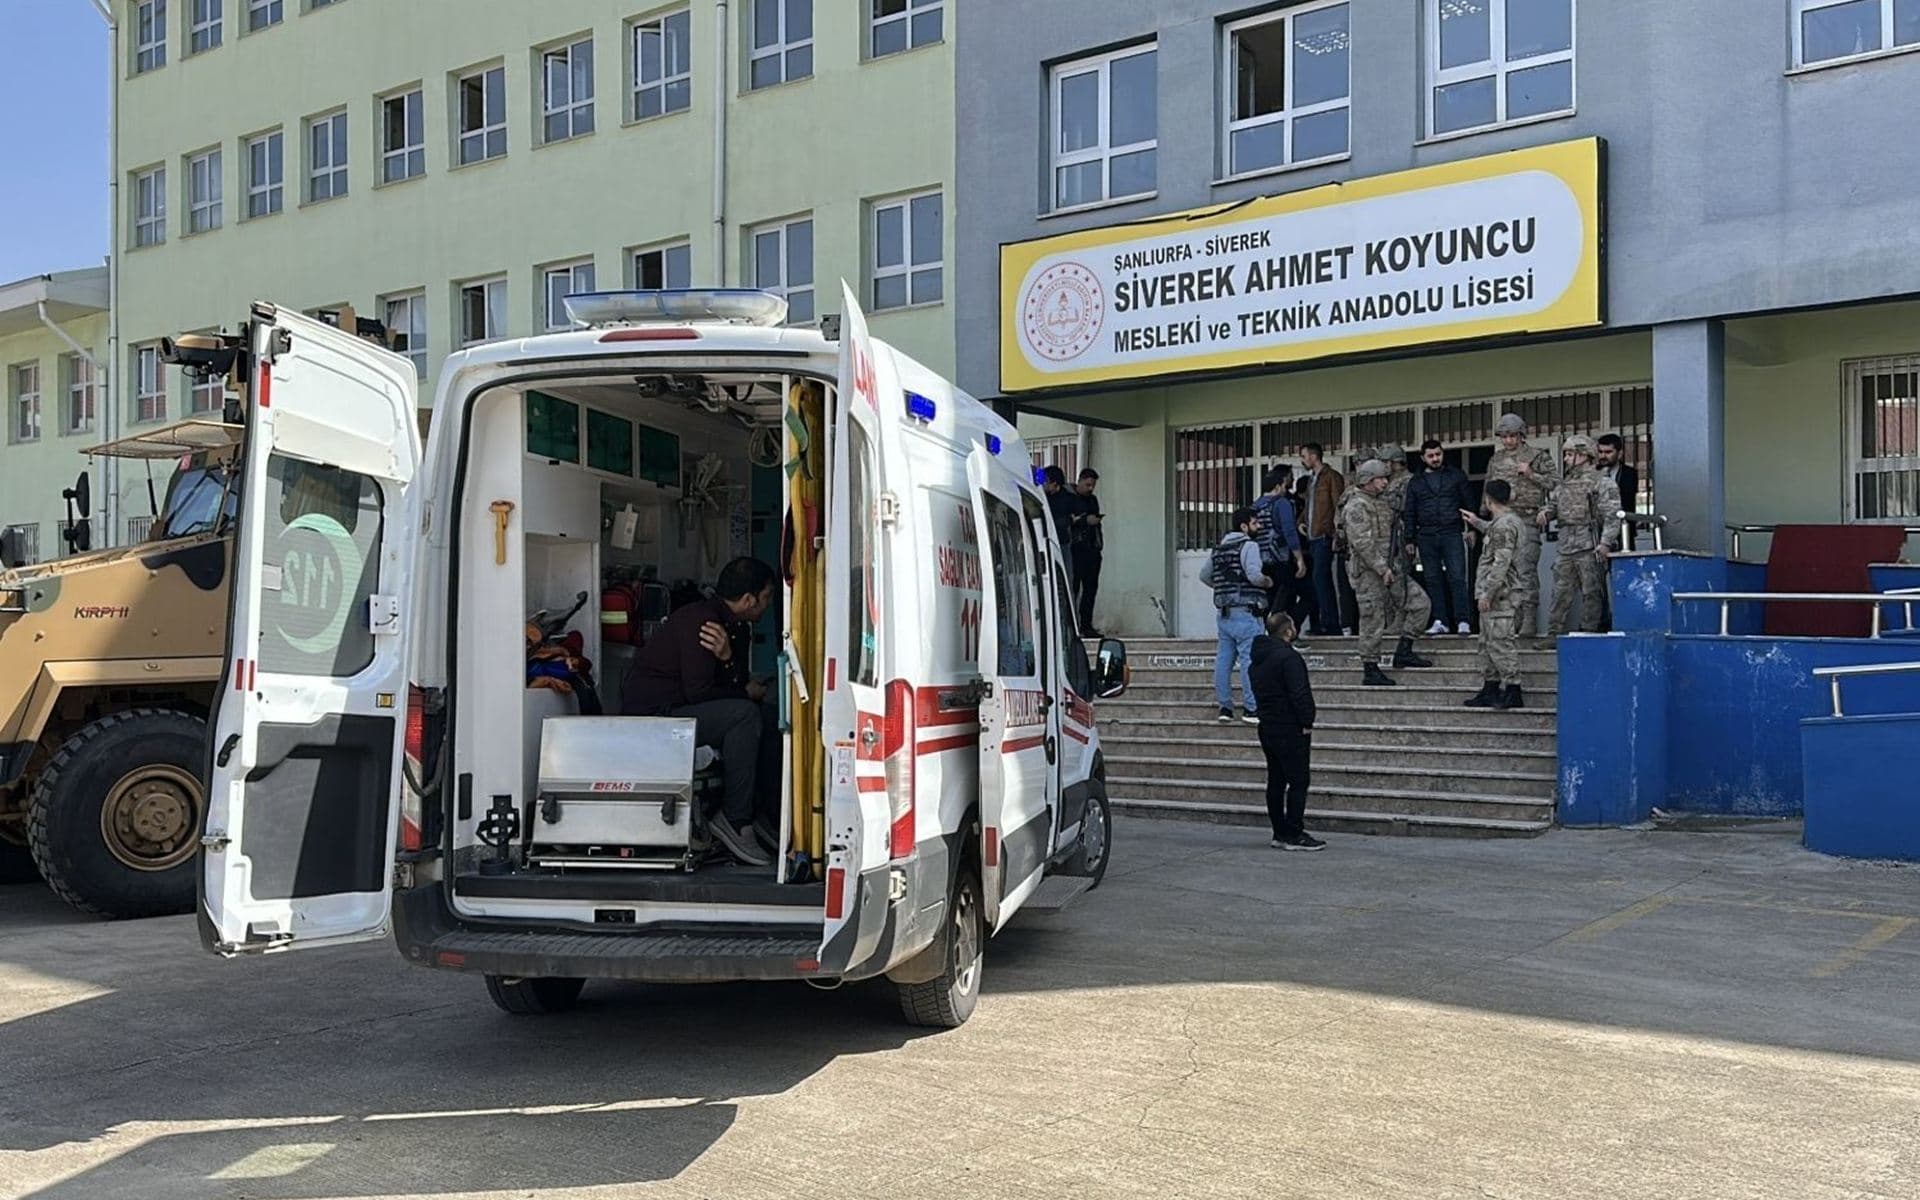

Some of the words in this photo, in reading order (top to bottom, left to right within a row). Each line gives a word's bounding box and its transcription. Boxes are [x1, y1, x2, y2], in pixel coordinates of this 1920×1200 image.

[1114, 244, 1193, 276] ŞANLIURFA
[1206, 230, 1271, 256] SİVEREK
[1115, 265, 1236, 312] SİVEREK
[1245, 246, 1354, 293] AHMET
[1365, 217, 1536, 276] KOYUNCU
[1115, 315, 1201, 352] MESLEKİ
[1208, 322, 1231, 341] ve
[1238, 300, 1321, 337] TEKNİK
[1328, 287, 1443, 325] ANADOLU
[1453, 268, 1533, 309] LİSESİ
